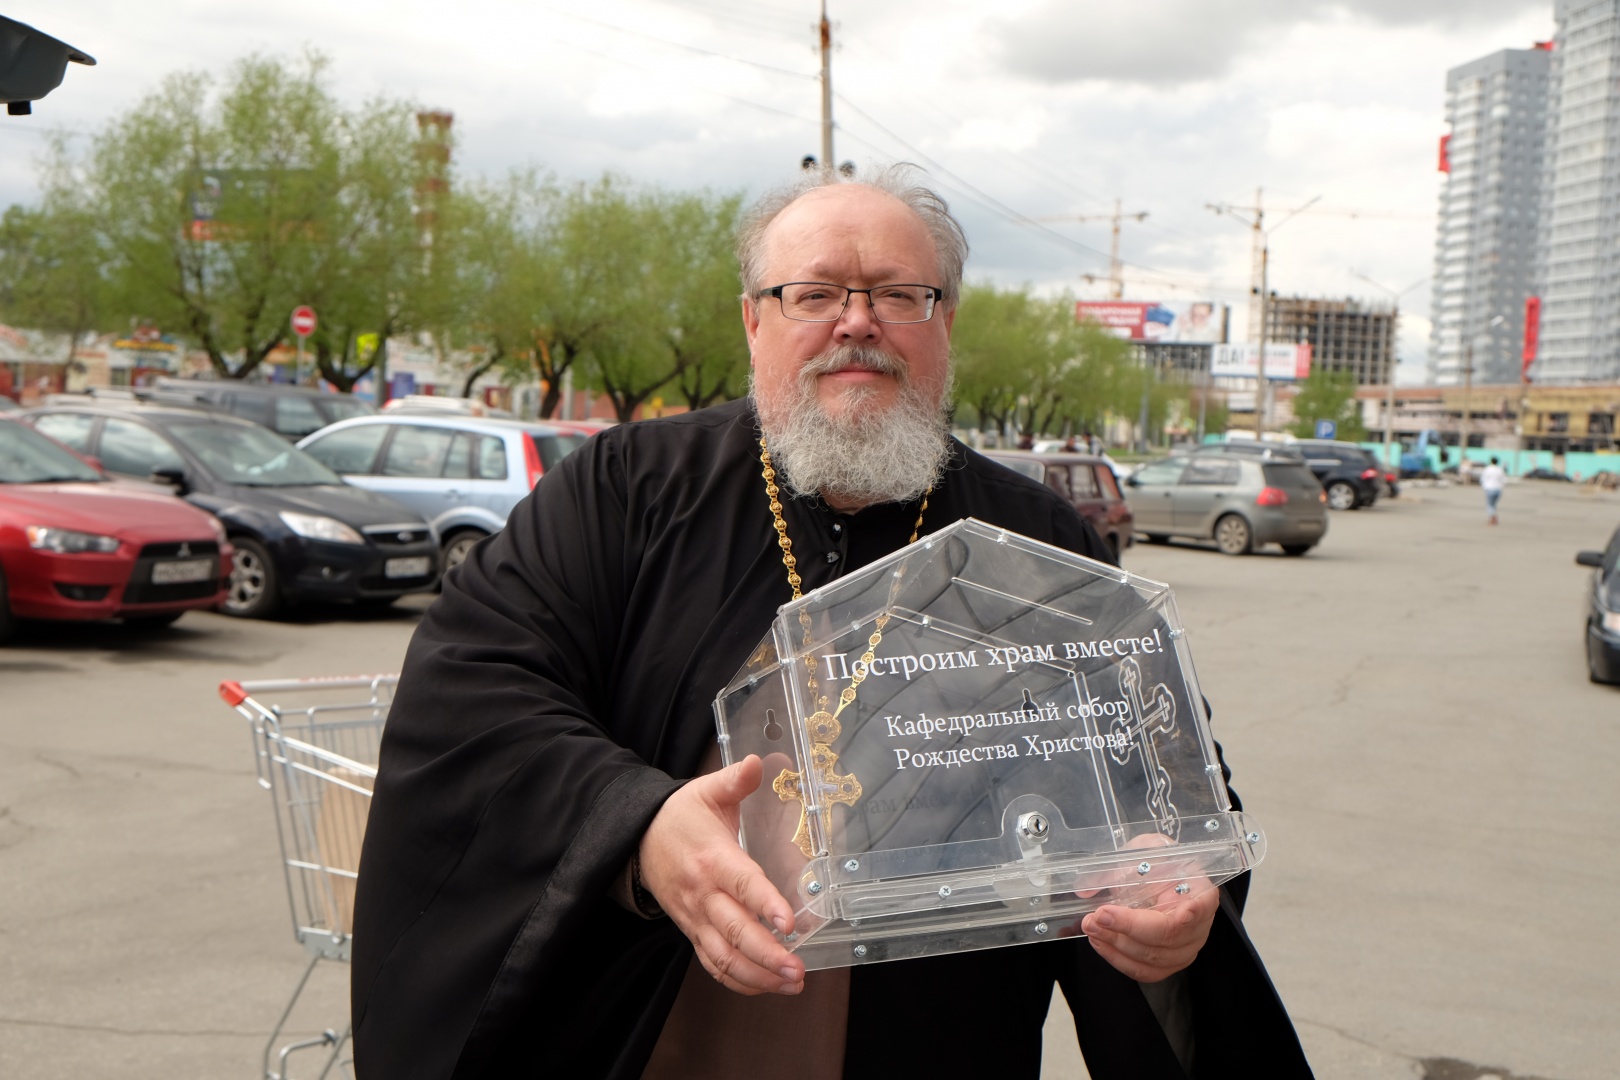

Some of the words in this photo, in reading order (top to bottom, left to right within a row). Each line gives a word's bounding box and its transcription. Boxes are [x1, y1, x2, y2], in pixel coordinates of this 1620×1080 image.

[821, 649, 980, 681] Построим
[985, 644, 1058, 673] храм
[1062, 628, 1164, 660] вместе!
[883, 701, 1062, 740] Кафедральный
[1066, 696, 1129, 721] собор
[893, 742, 1020, 770] Рождества
[1021, 725, 1135, 762] Христова!
